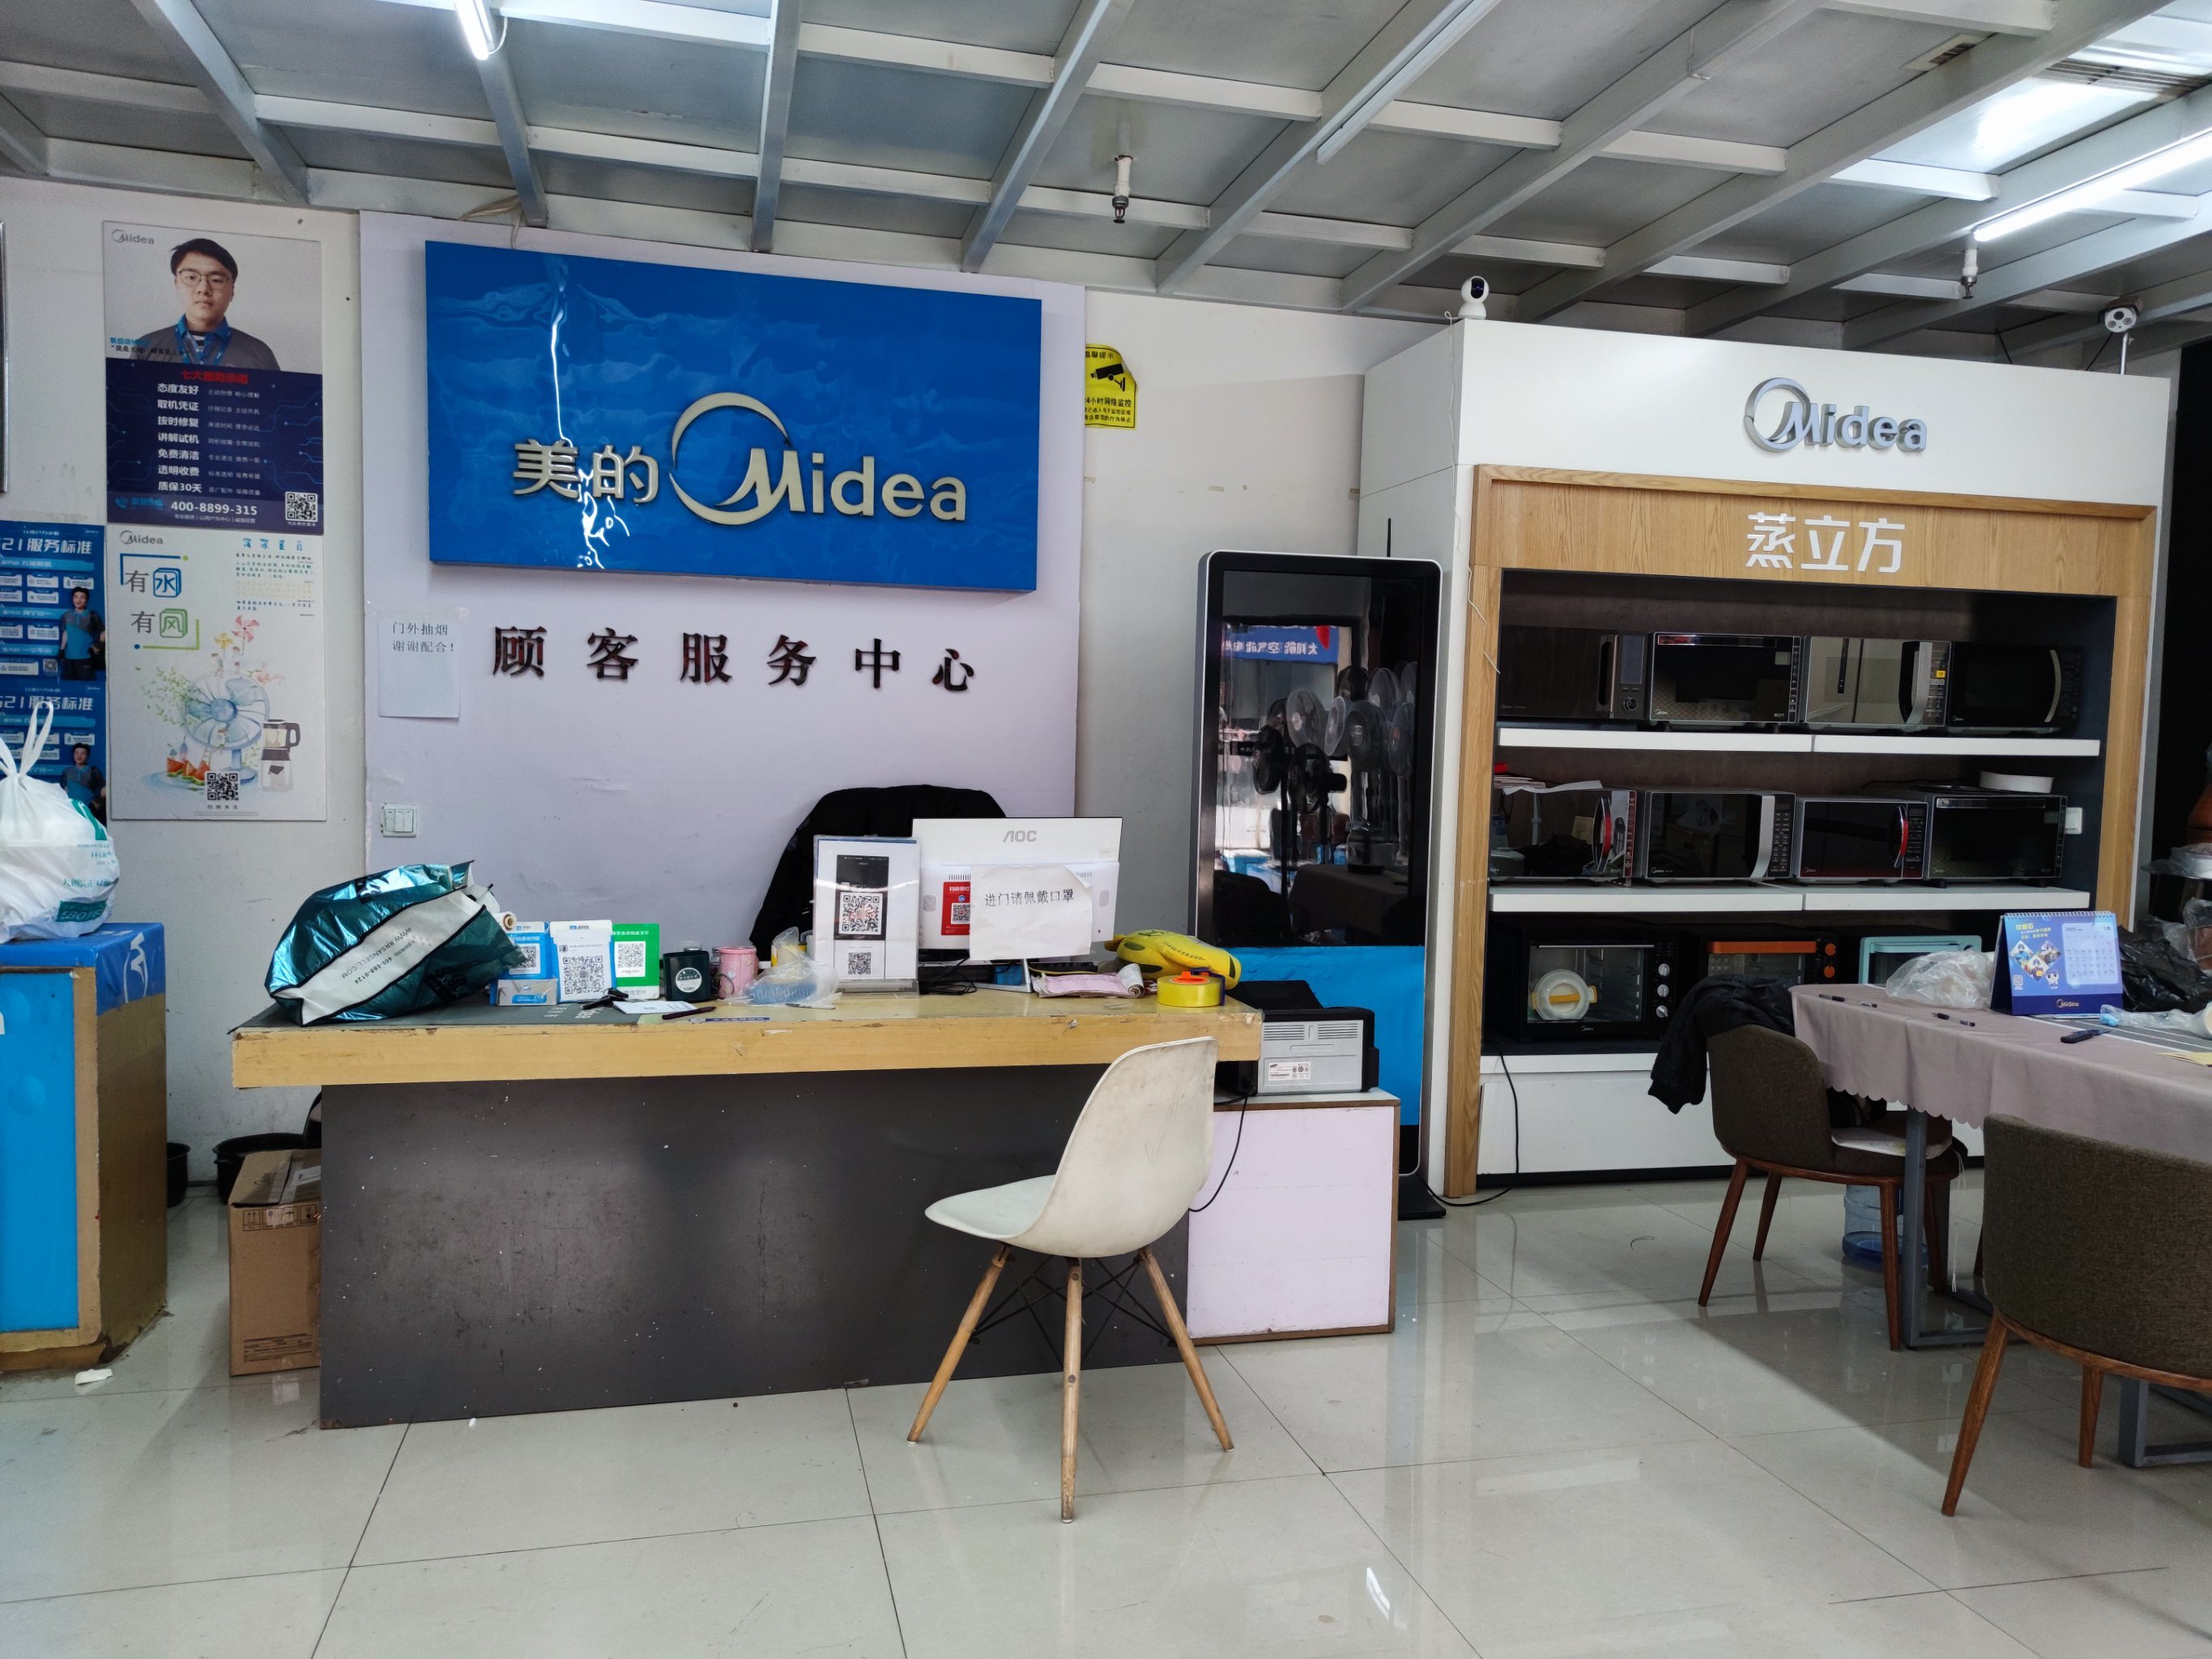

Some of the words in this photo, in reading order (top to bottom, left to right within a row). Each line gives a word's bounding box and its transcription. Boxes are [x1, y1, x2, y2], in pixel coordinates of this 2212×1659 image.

[112, 229, 155, 244] Midea
[157, 383, 199, 395] 态度友好
[157, 399, 199, 412] 取机凭证
[1085, 397, 1132, 407] 4小时网络监控
[157, 416, 199, 428] 按时修复
[1743, 377, 1927, 454] Midea
[158, 432, 199, 445] 讲解试机
[158, 448, 199, 460] 免费清洁
[513, 438, 659, 502] 美的
[668, 392, 966, 526] Midea
[158, 464, 199, 477] 透明收费
[158, 481, 202, 493] 质保30天
[171, 501, 258, 515] 400-8899-315
[120, 531, 164, 545] Midea
[1745, 512, 1905, 573] 蒸立方
[0, 537, 92, 554] 21服务标准
[393, 622, 448, 636] 门外抽烟
[492, 626, 974, 692] 顾客服务中心
[1002, 830, 1038, 842] AOC
[984, 889, 1074, 906] 进门请佩戴口罩
